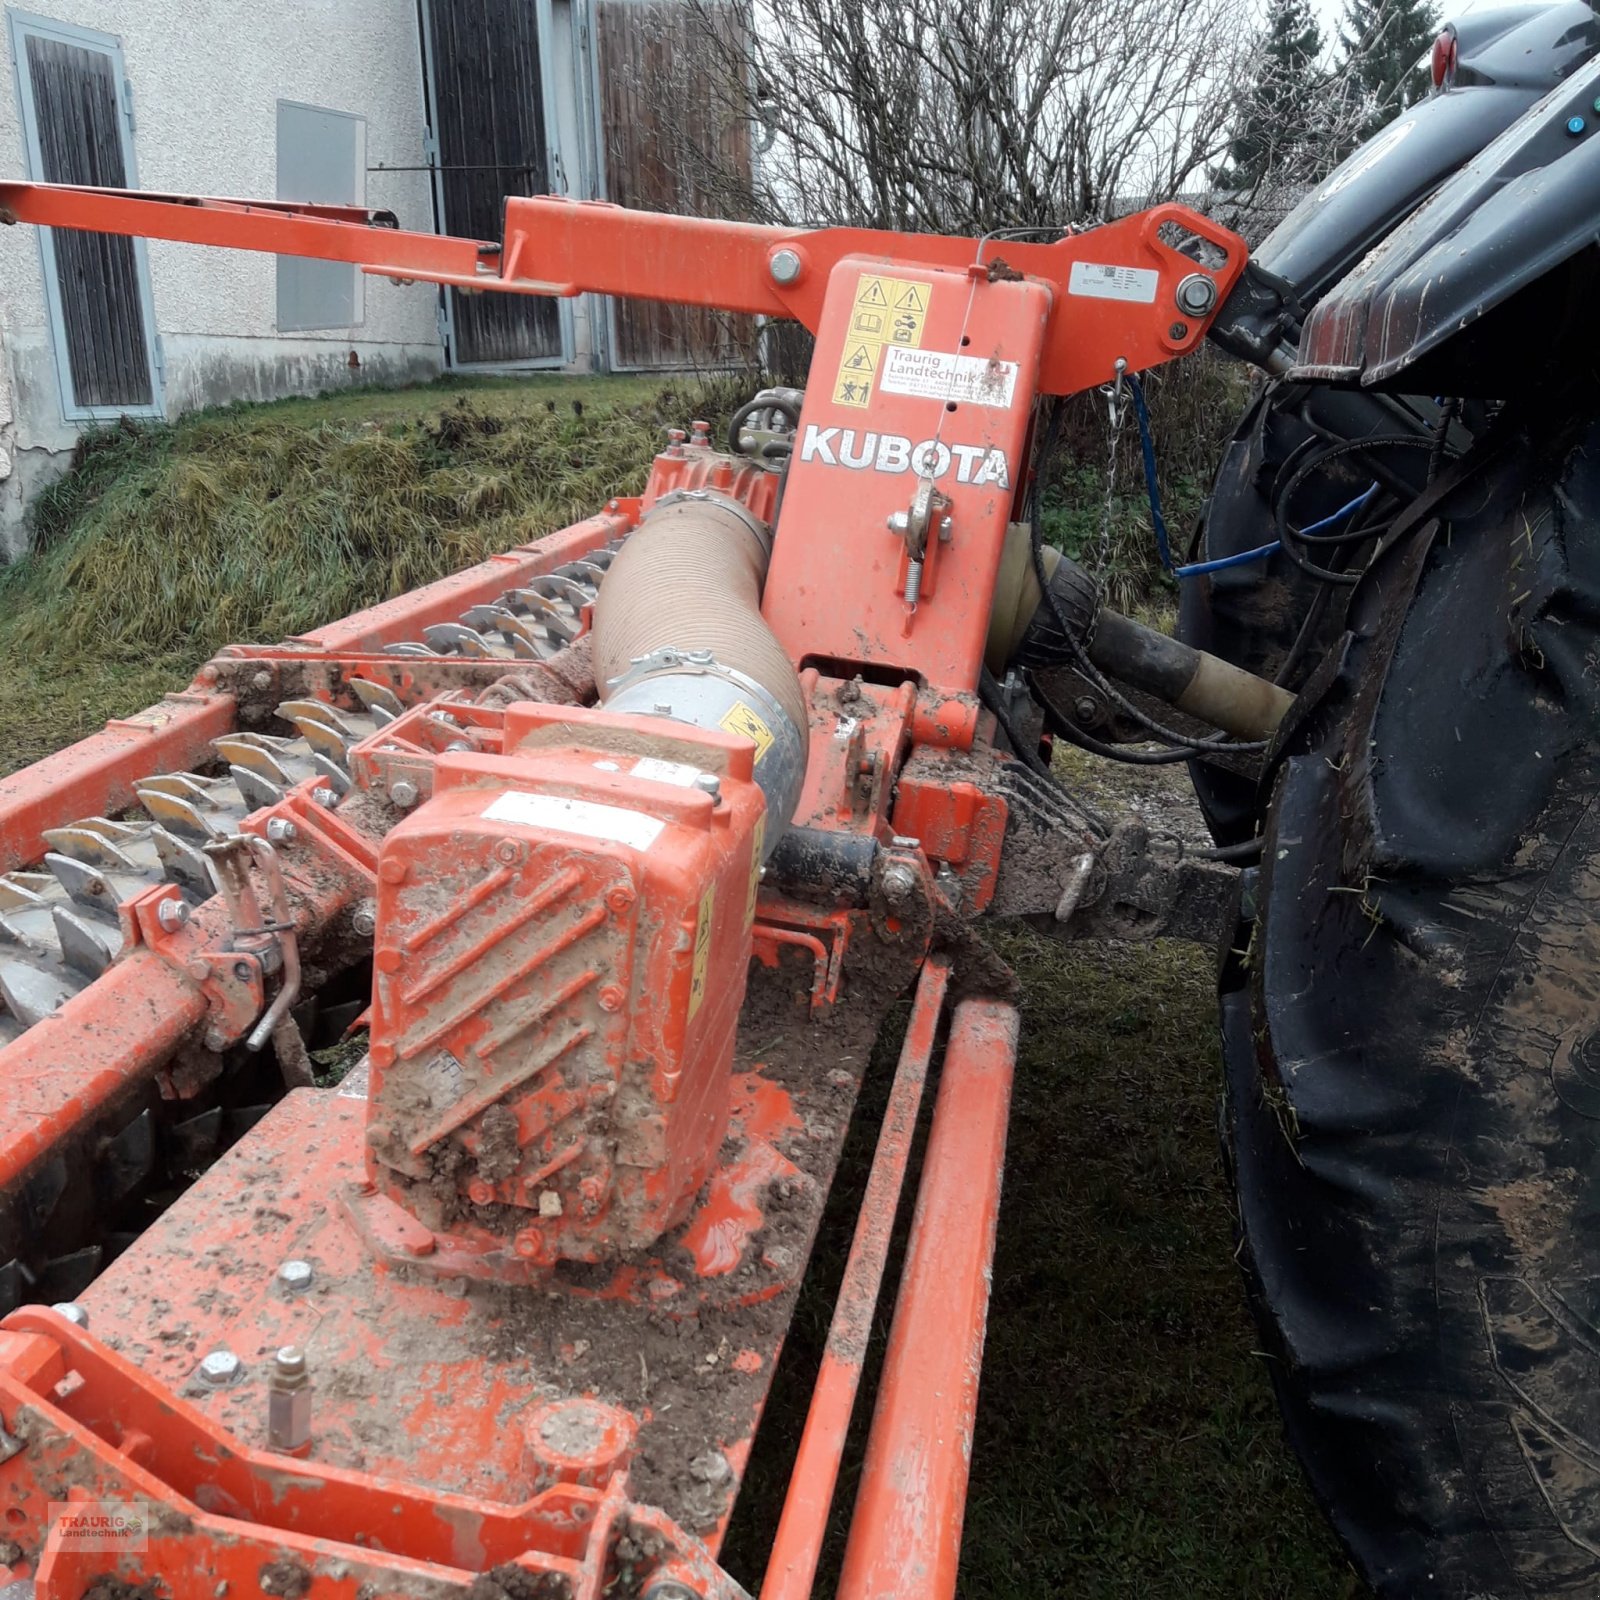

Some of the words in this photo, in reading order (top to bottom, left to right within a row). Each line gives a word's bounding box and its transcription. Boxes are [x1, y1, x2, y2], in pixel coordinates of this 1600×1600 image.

[893, 349, 941, 369] Traurig
[889, 362, 976, 384] Landtechnik
[800, 424, 1010, 490] KUBOTA
